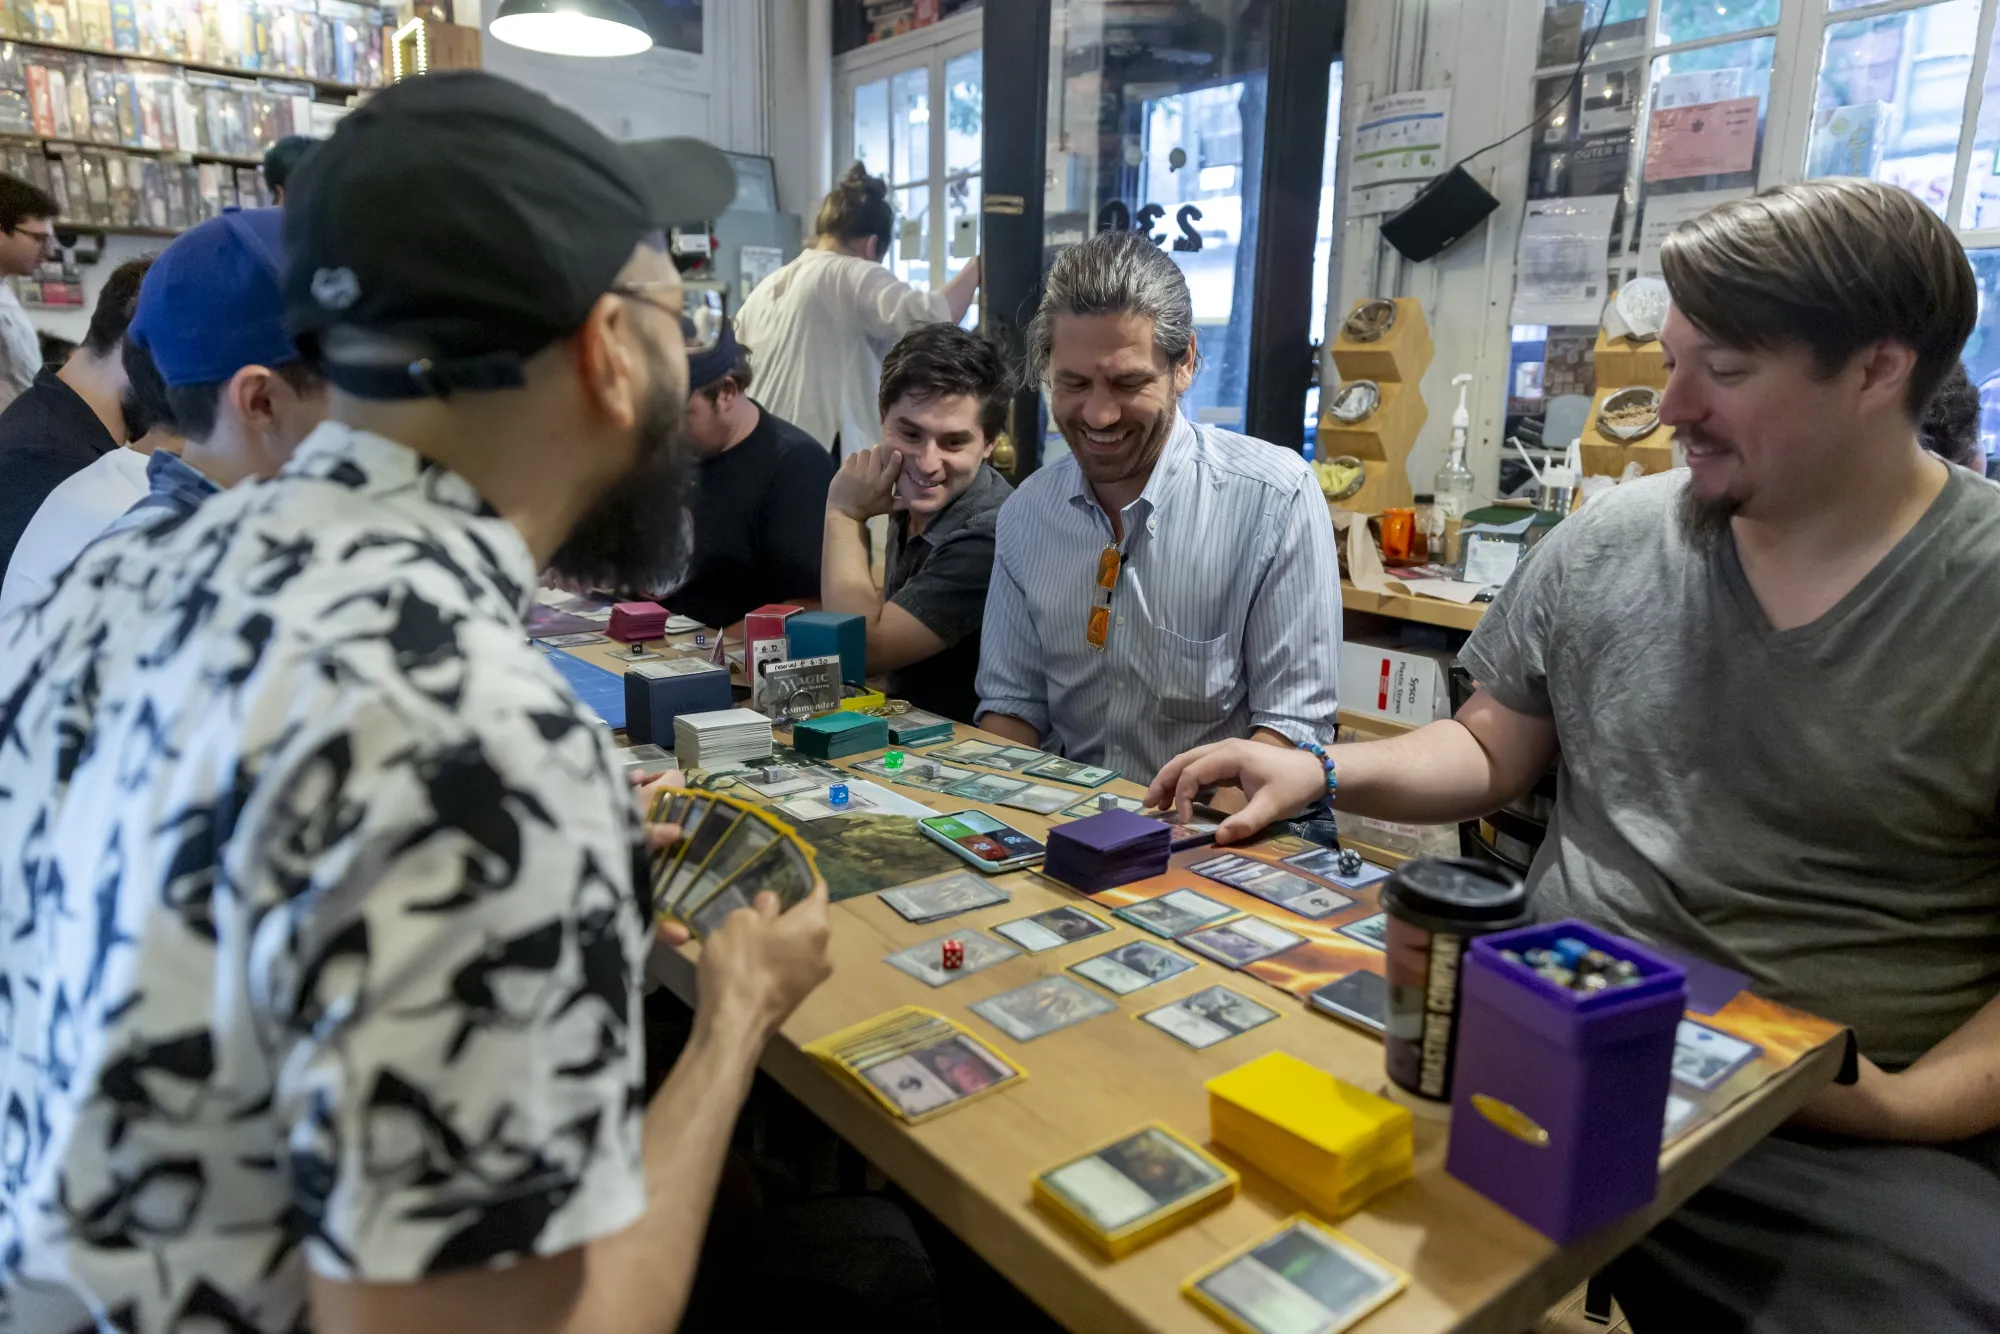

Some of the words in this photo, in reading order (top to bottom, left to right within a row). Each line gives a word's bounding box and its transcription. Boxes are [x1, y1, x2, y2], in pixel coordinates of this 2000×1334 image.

[1397, 661, 1406, 687] Plastic
[1395, 688, 1404, 714] Straws
[1408, 677, 1419, 704] Sysco
